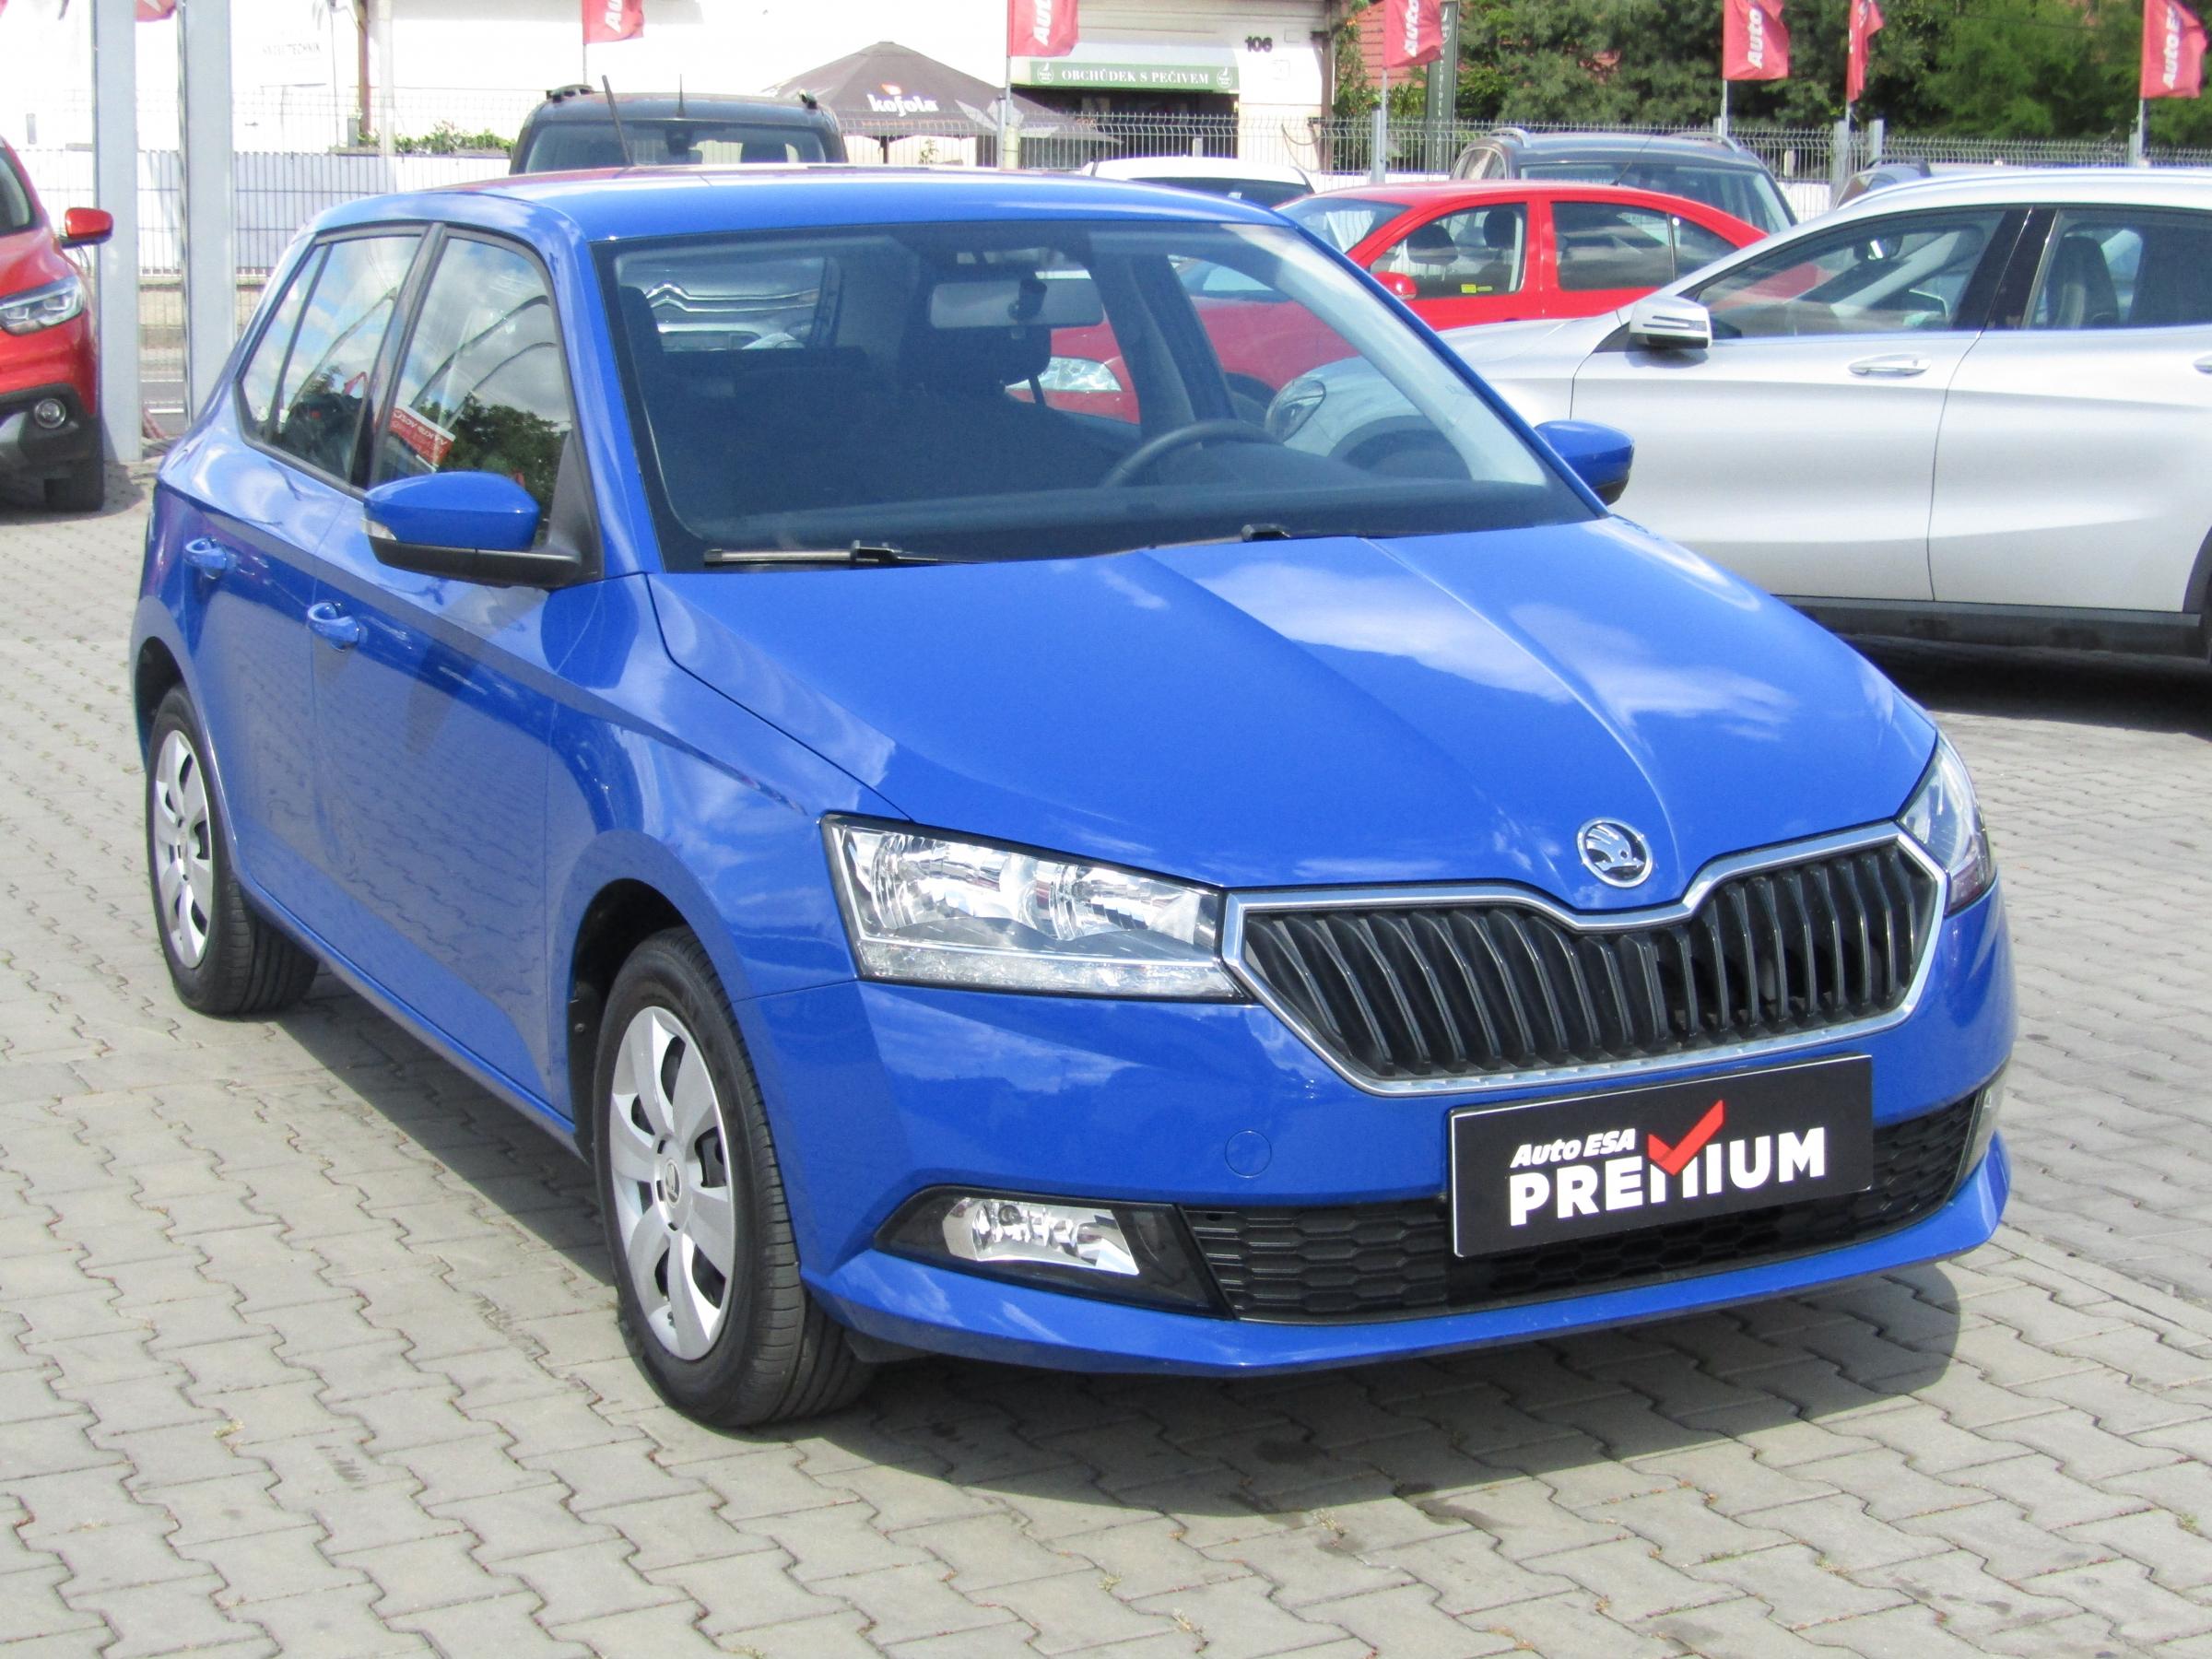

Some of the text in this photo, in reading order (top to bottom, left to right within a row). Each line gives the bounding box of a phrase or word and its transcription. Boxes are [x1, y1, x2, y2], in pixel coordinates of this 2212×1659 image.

[1244, 36, 1273, 53] 106
[1747, 7, 1763, 70] Auto
[1061, 68, 1135, 83] OBCHŮDEK
[1140, 72, 1147, 83] S
[1151, 71, 1209, 85] PEČIVEM
[2162, 33, 2179, 89] Auto
[866, 94, 939, 117] kofola
[1510, 1127, 1637, 1168] Auto ESA
[1510, 1127, 1826, 1227] PREMIUM
